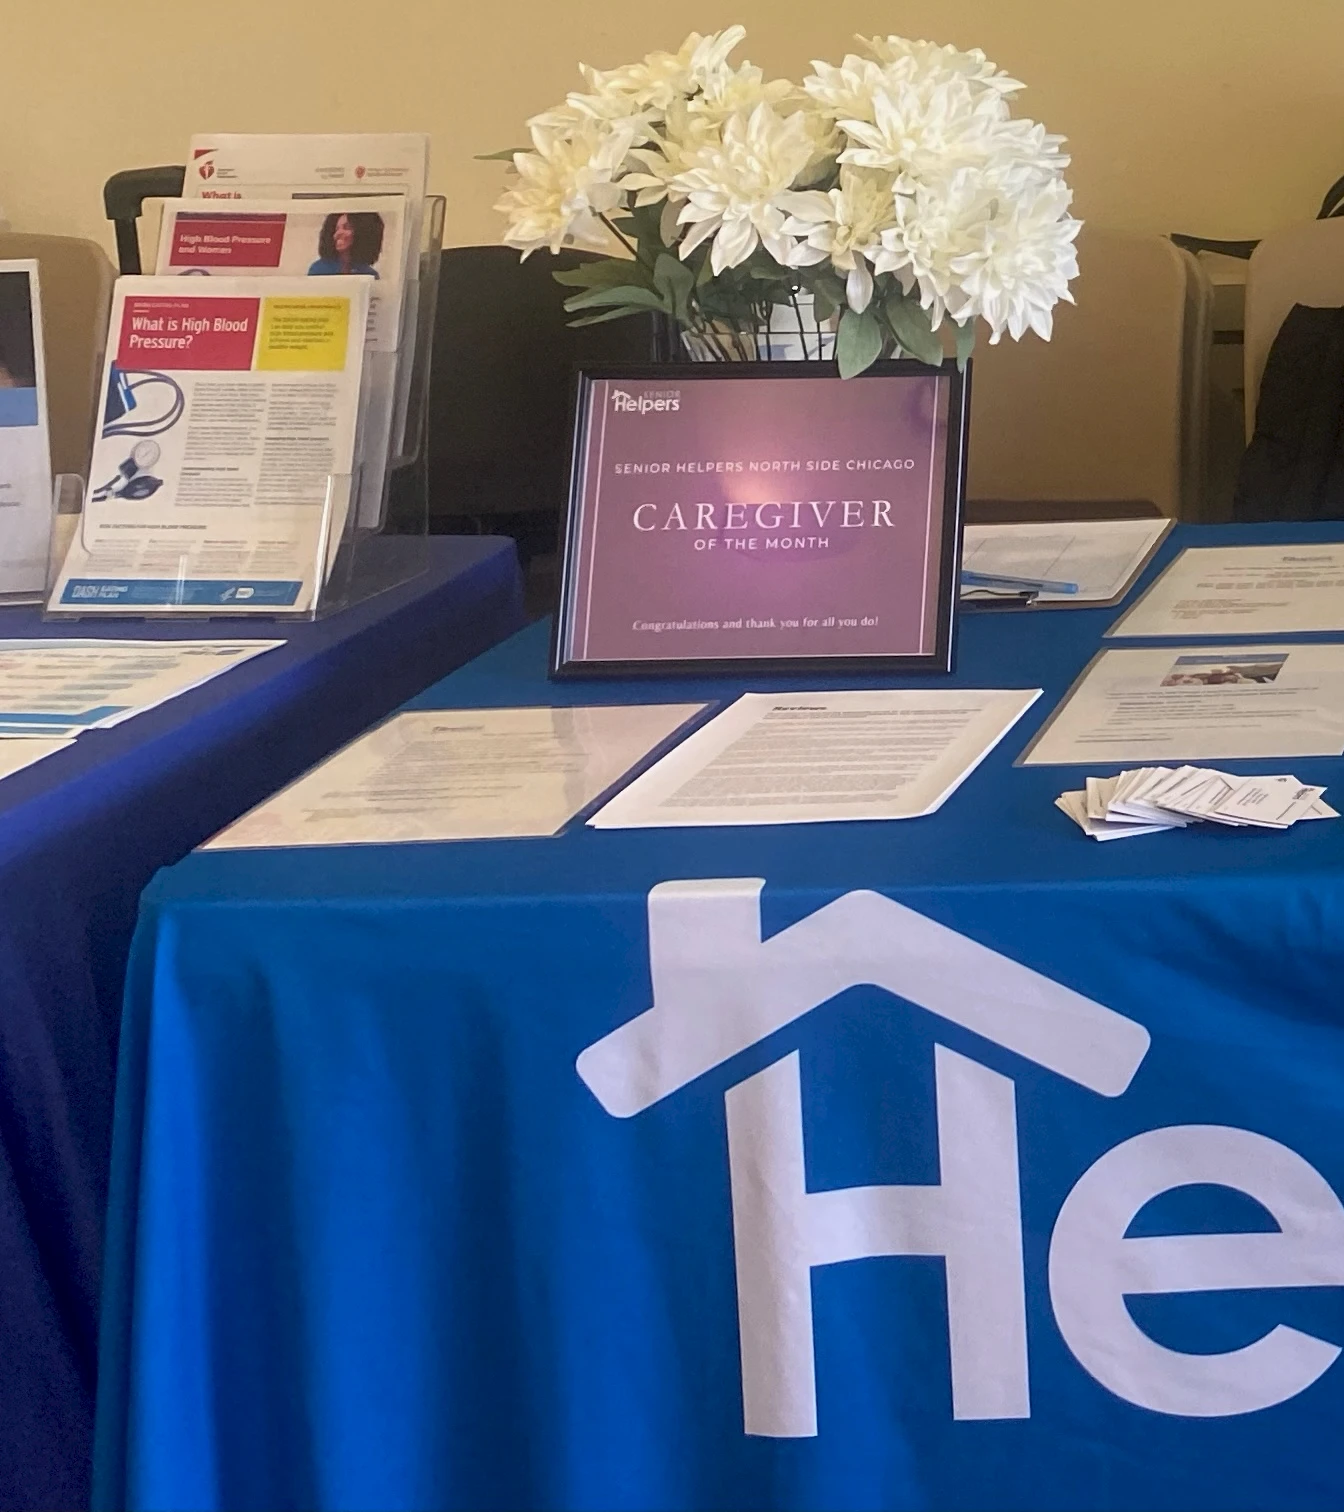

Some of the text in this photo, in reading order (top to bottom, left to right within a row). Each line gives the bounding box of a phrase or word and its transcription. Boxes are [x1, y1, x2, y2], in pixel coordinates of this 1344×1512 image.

[132, 316, 248, 334] What is High Blood
[129, 334, 193, 350] Pressure?
[614, 394, 680, 415] Helpers
[615, 458, 915, 474] SENIOR HELPERS NORTH SIDE CHICAGO
[633, 499, 895, 531] CAREGIVER
[694, 536, 829, 550] OF THE MONTH
[632, 615, 879, 632] Congratulations and thank you for all you do!
